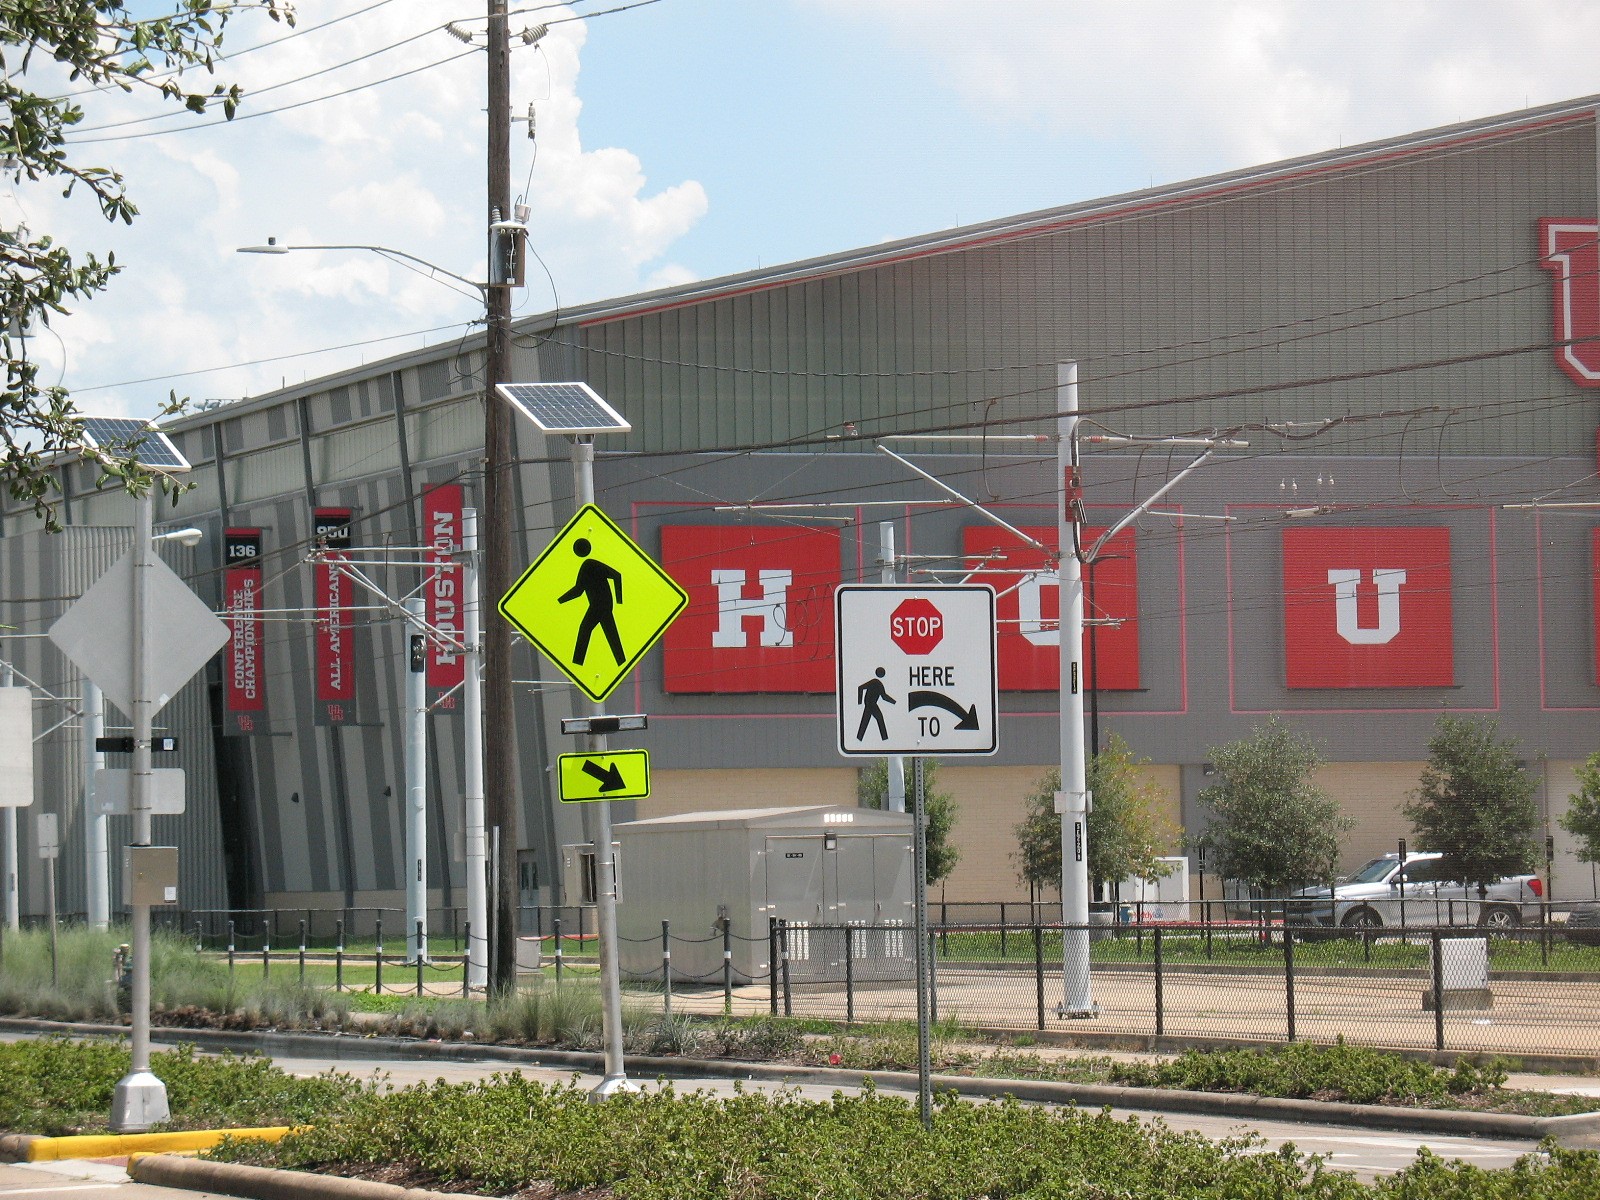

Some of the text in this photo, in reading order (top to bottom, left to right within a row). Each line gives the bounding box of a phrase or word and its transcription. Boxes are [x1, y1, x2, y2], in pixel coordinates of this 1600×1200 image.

[229, 545, 256, 557] 136
[434, 511, 456, 666] HOUSTON
[711, 569, 793, 647] H
[1327, 569, 1406, 644] U
[233, 589, 245, 689] CONFERENCE
[243, 578, 256, 699] CHAMPIONSHIPS
[893, 616, 941, 637] STOP
[909, 666, 955, 687] HERE
[917, 716, 940, 737] TO
